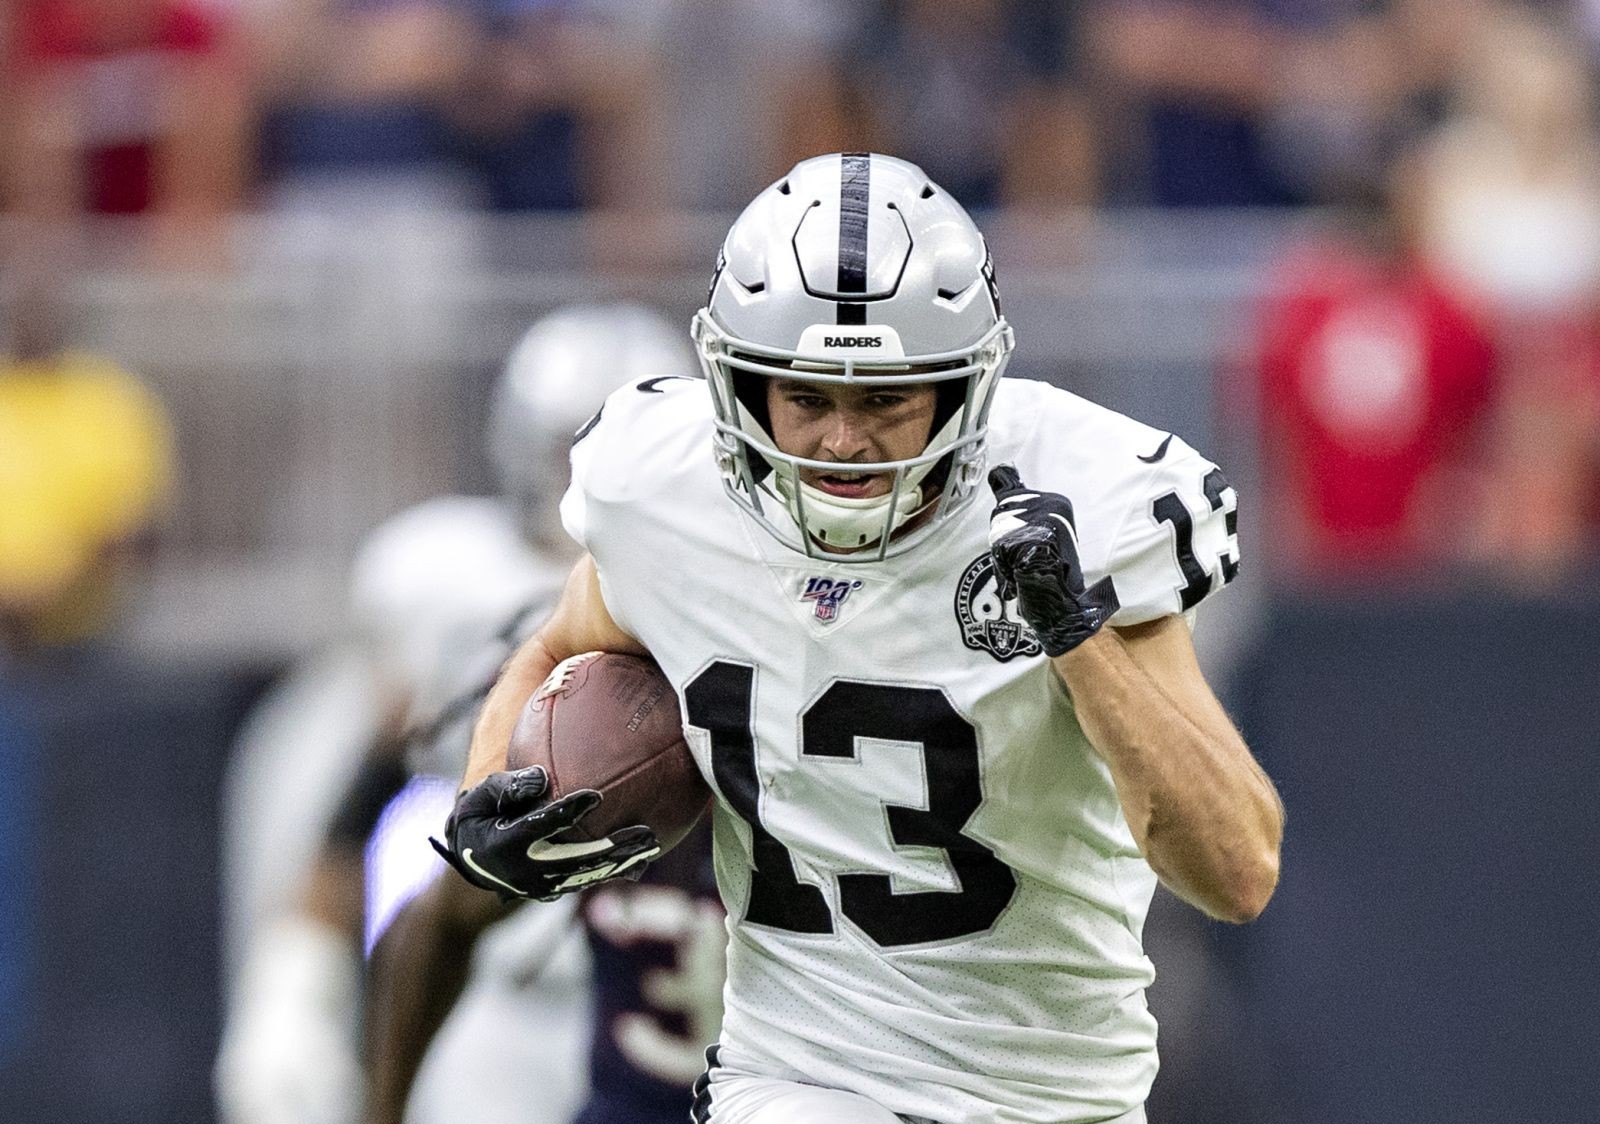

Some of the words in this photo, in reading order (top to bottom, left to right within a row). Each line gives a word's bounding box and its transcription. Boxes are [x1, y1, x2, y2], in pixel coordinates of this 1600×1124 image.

[824, 336, 882, 348] RAIDERS
[960, 562, 984, 623] AMERICAN
[683, 657, 1018, 947] 13
